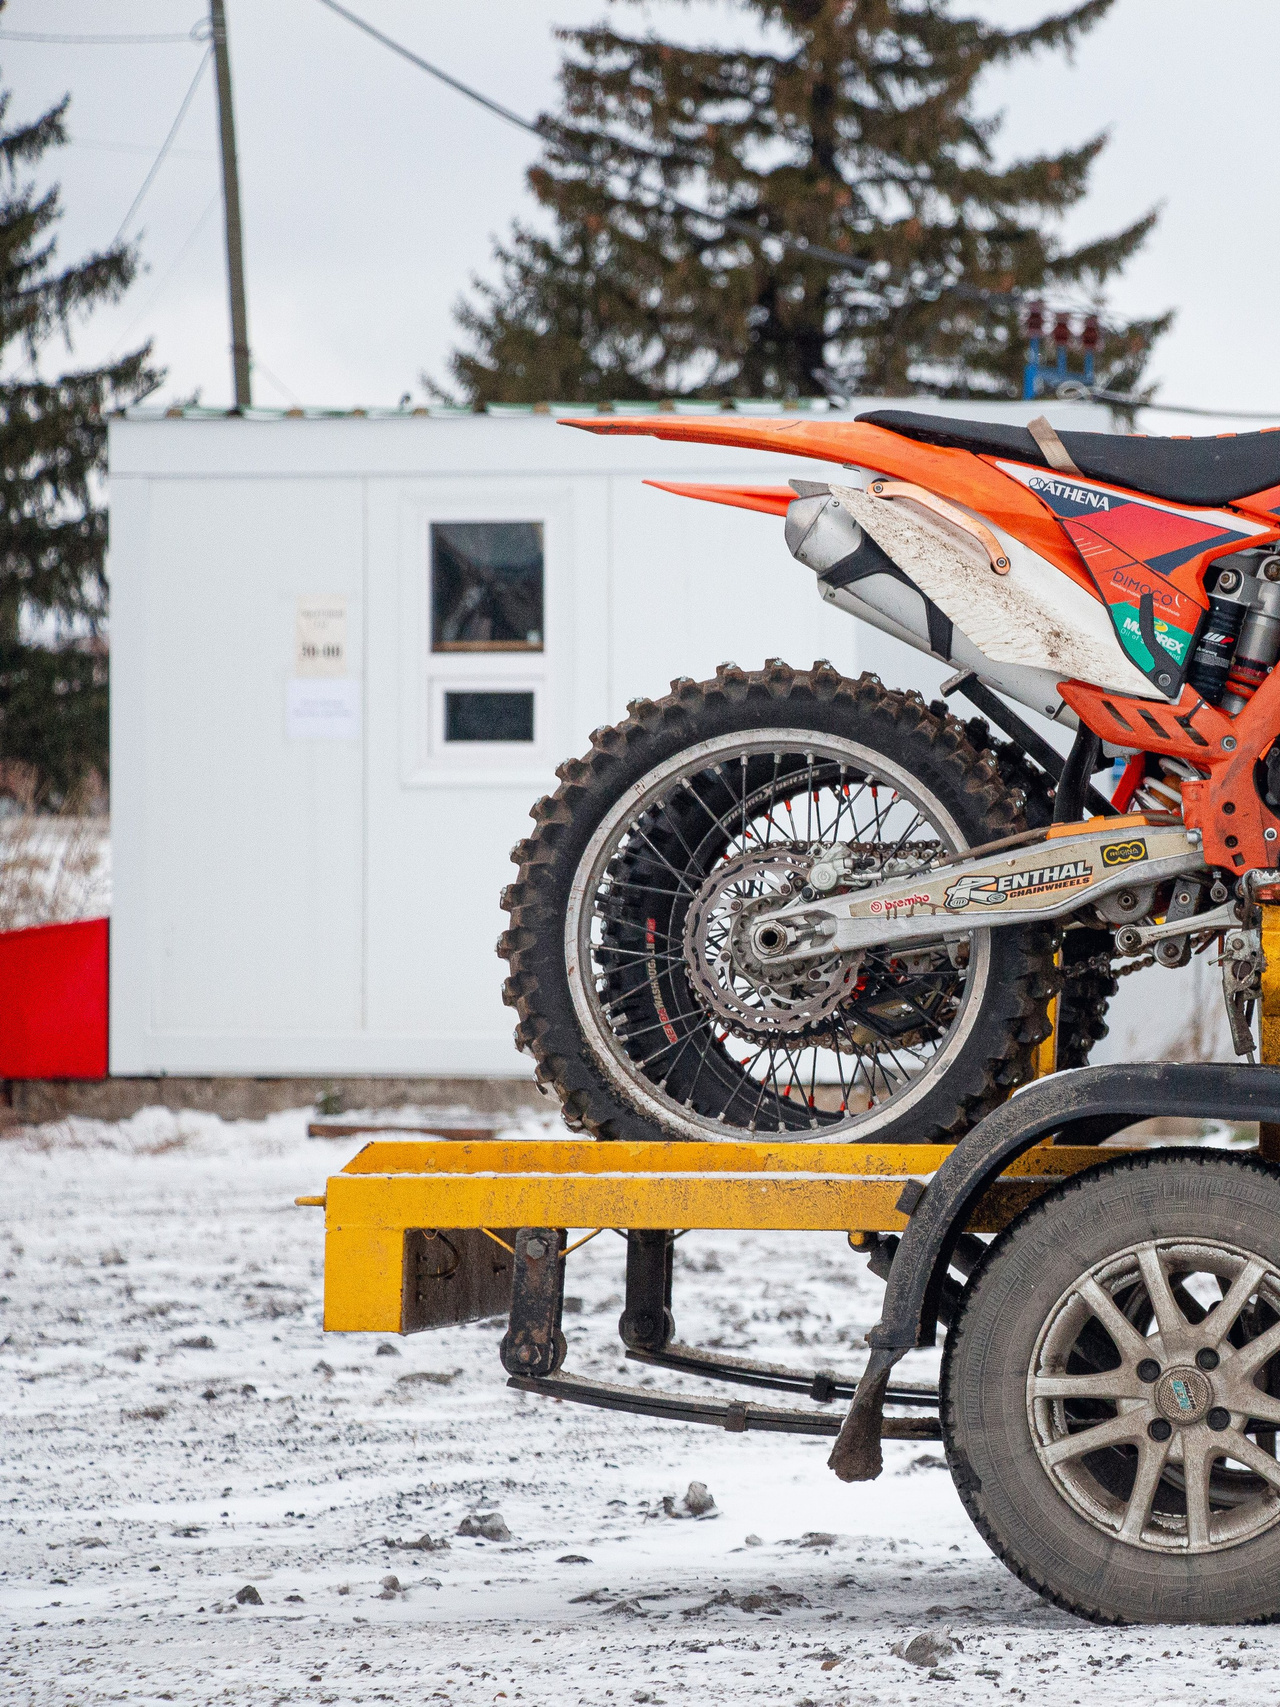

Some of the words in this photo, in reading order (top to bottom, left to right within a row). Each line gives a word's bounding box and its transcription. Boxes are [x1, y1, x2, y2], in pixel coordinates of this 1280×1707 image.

[1043, 481, 1110, 511] ATHENA
[1113, 571, 1172, 605] DIMOCO
[1123, 617, 1184, 654] MOOREX
[885, 894, 930, 911] brembo
[1010, 877, 1090, 899] CHAINWHEELS
